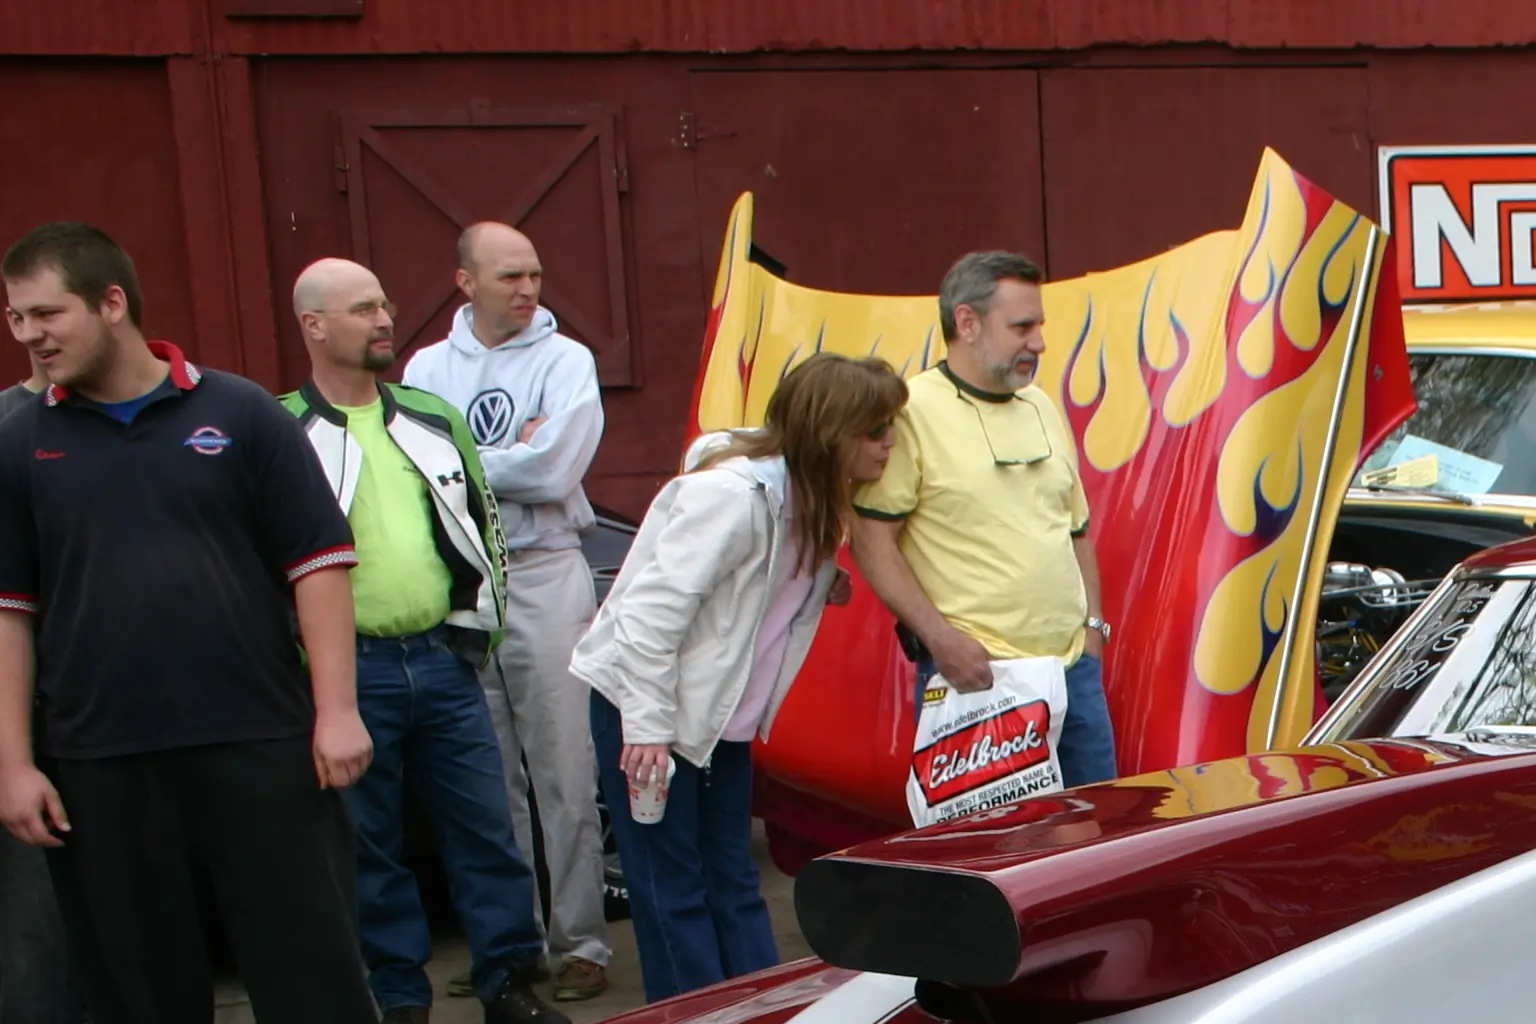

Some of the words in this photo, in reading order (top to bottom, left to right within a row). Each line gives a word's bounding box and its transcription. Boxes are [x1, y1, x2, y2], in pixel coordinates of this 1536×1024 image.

[931, 695, 1017, 738] www.edelbrock.com
[929, 719, 1043, 790] Edelbrock
[939, 803, 955, 818] THE
[955, 794, 976, 810] MOST
[1022, 769, 1044, 784] NAME
